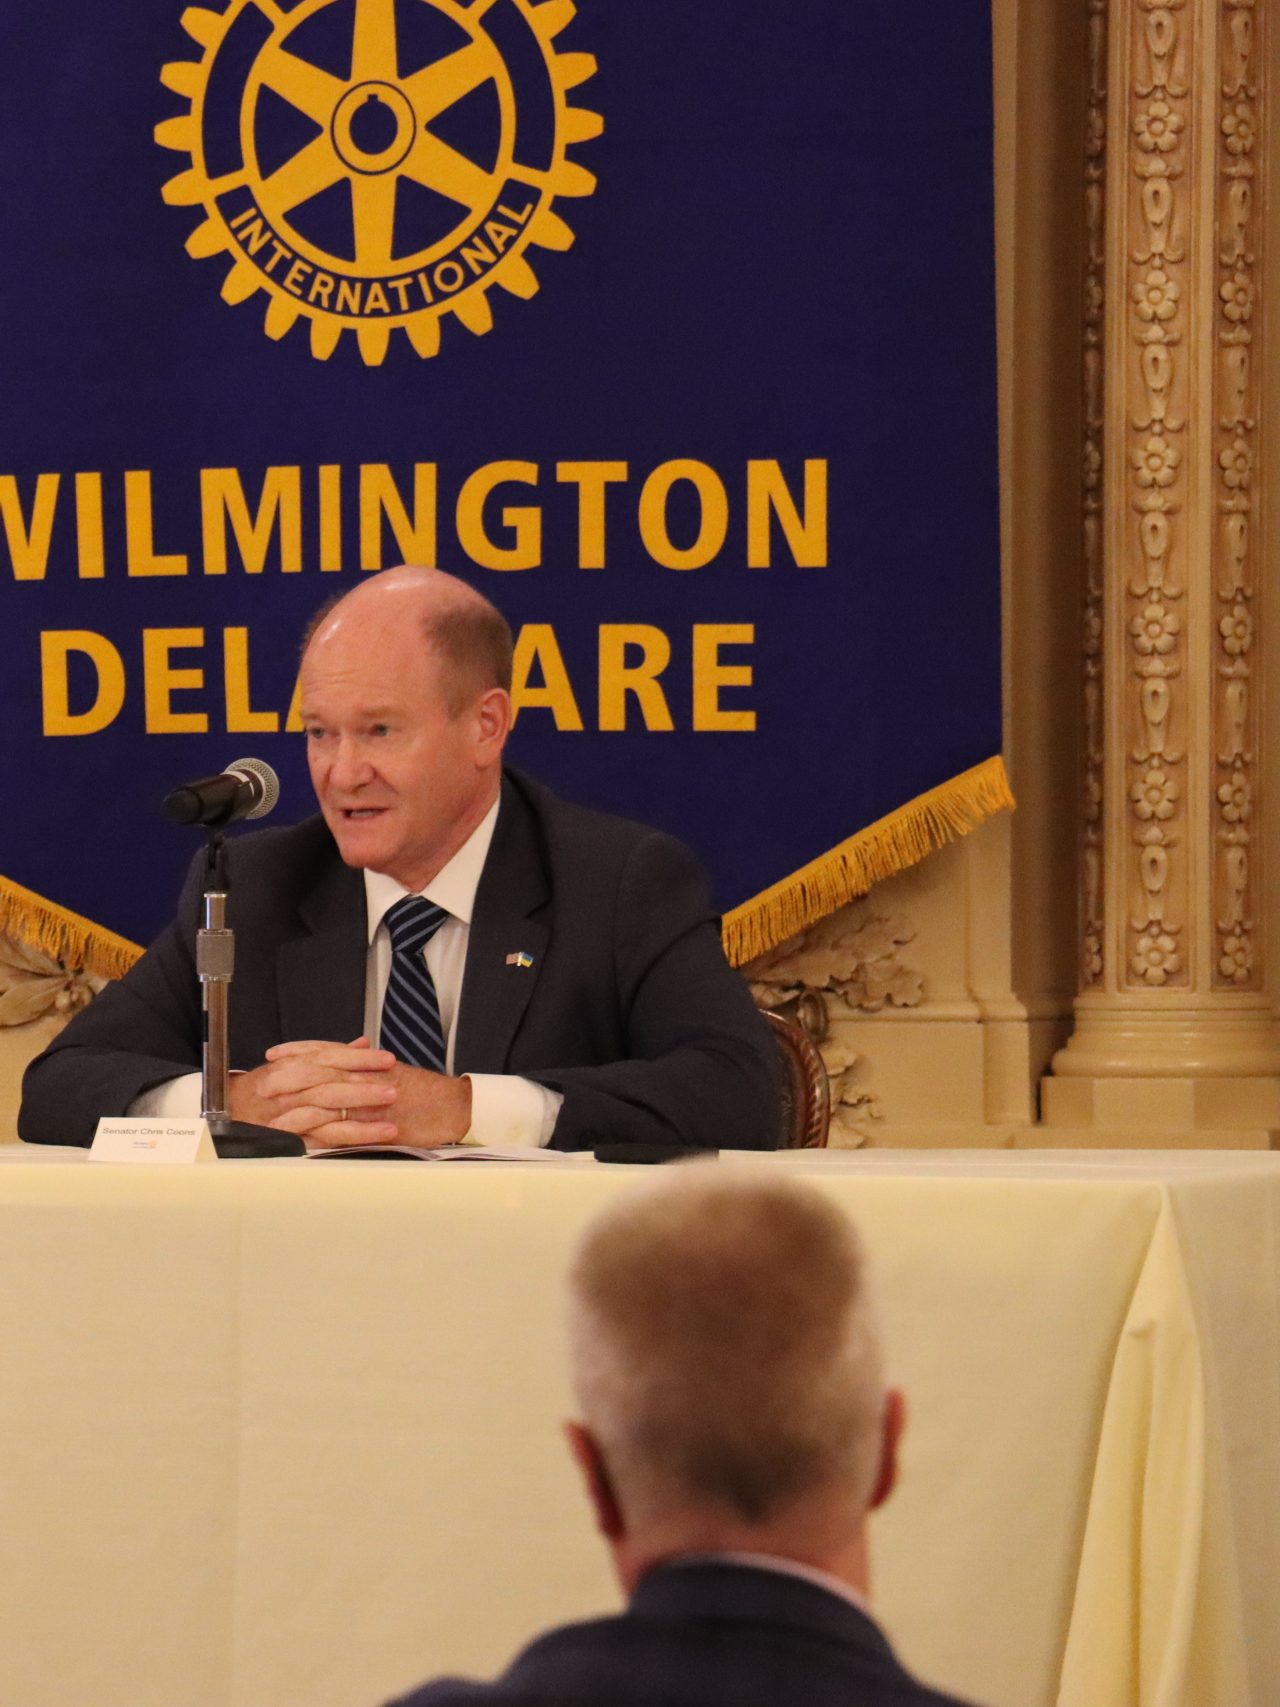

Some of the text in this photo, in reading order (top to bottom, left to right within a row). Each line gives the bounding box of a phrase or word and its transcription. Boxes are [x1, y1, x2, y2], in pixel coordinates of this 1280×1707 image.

[230, 202, 534, 315] INTERNATIONAL
[40, 622, 758, 738] DELARE
[102, 1127, 138, 1136] Senator
